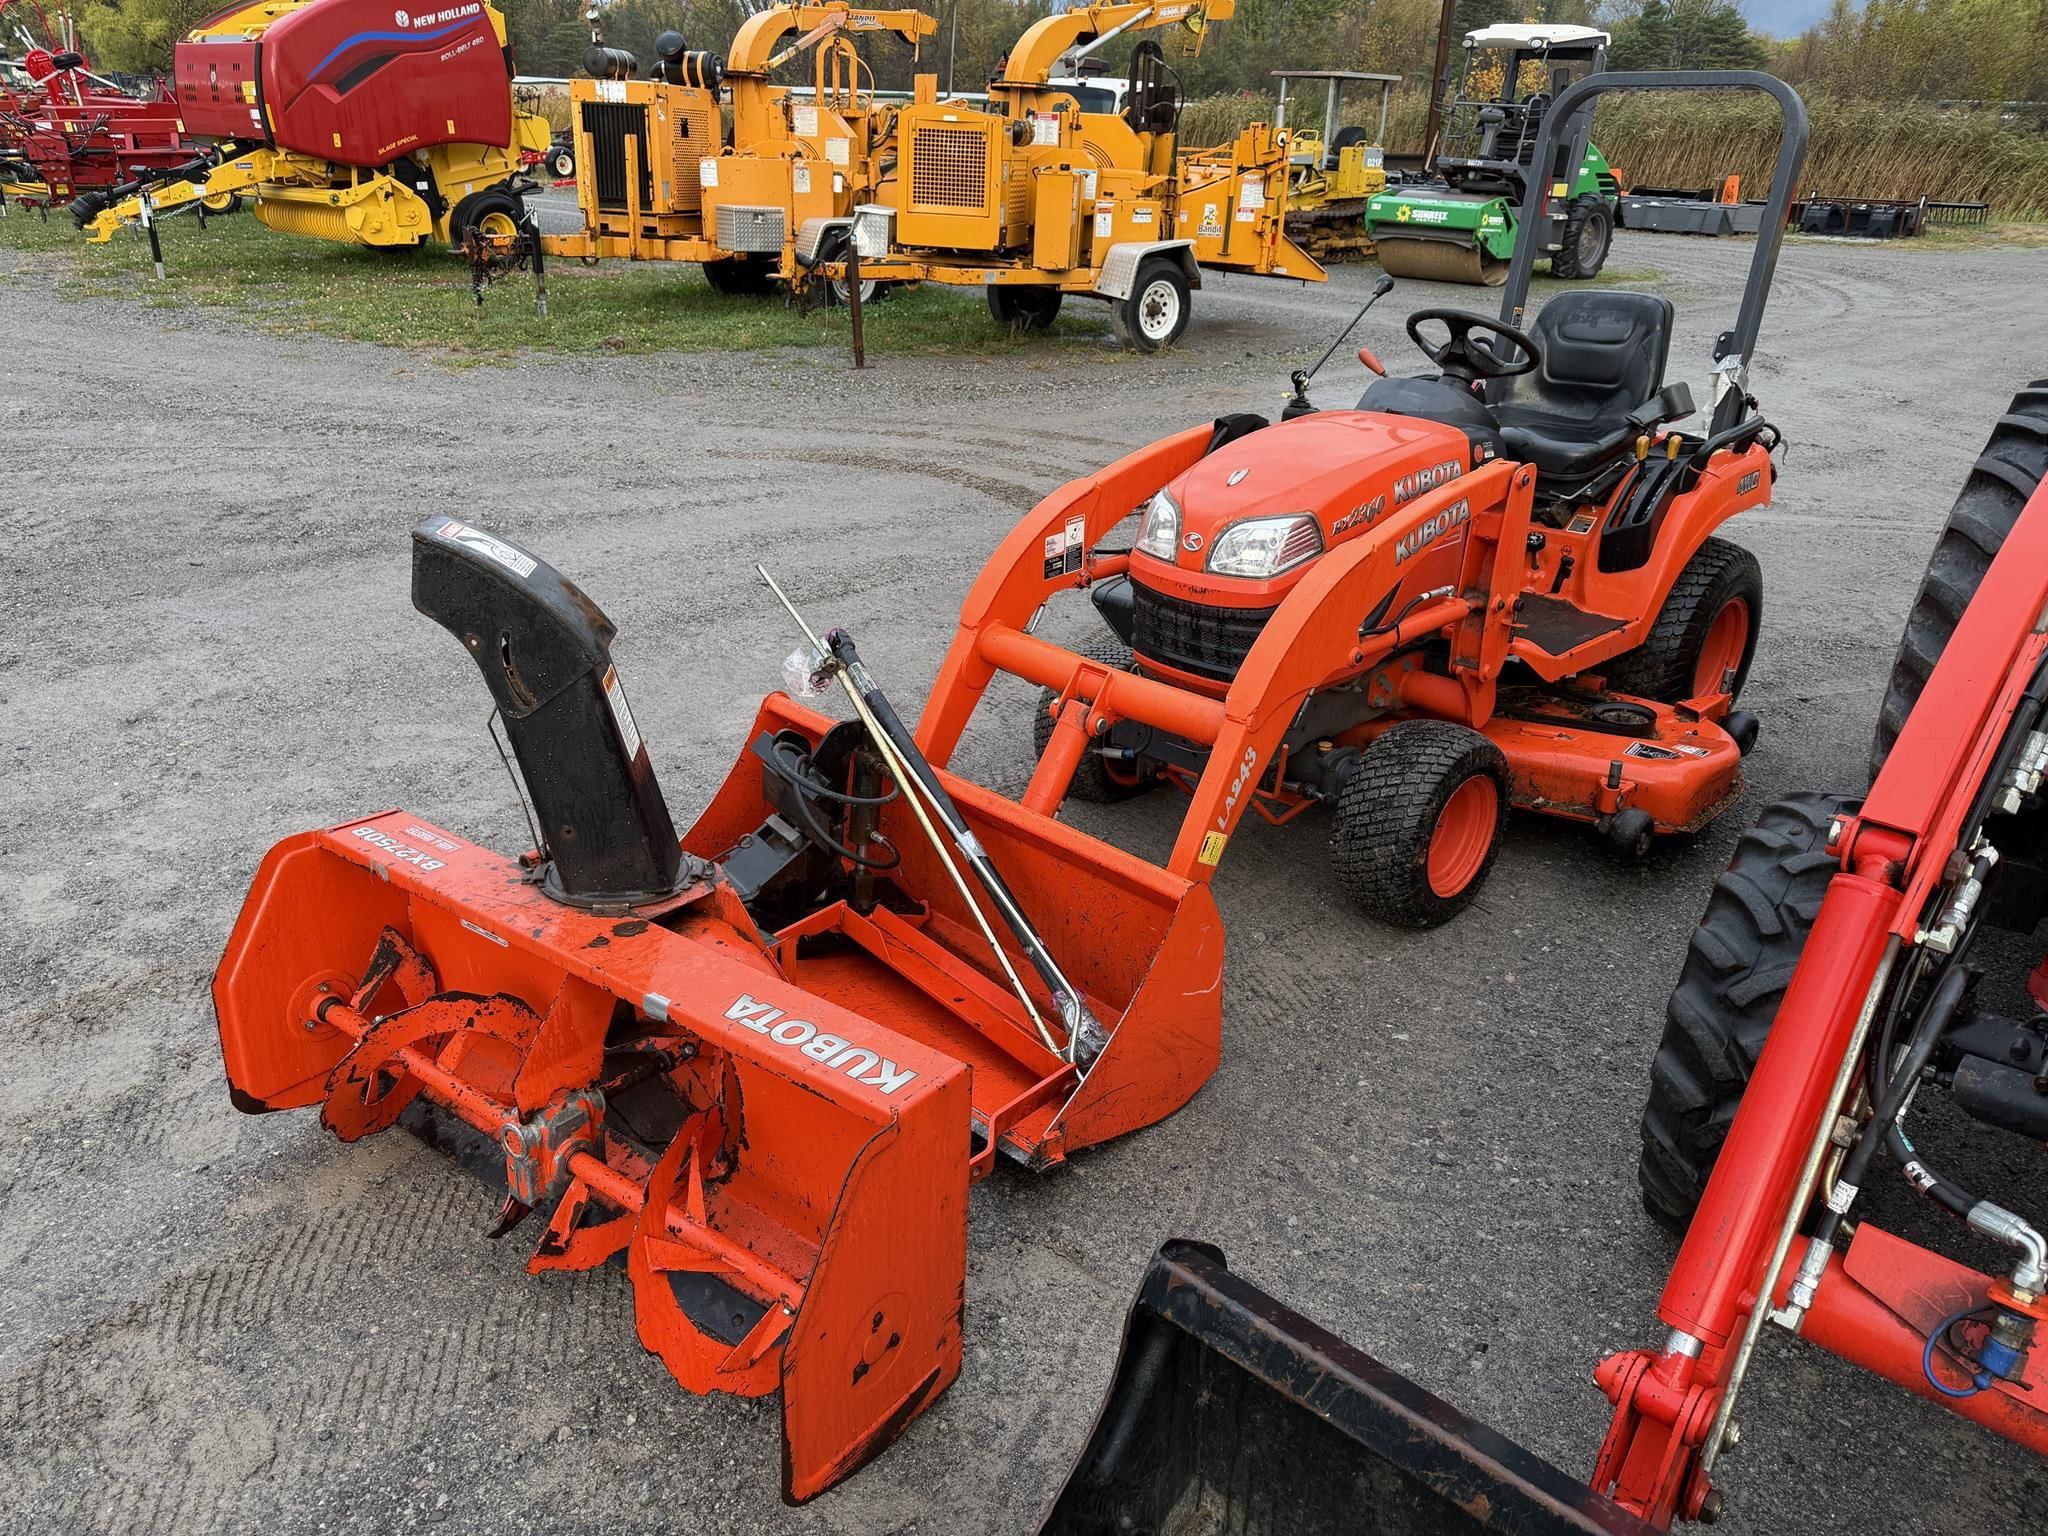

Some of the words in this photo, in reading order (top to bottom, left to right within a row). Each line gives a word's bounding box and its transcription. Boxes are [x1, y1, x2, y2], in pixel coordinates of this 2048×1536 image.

[413, 13, 436, 28] NEW
[437, 3, 480, 22] HOLLAND
[1198, 224, 1222, 233] Bandit
[1411, 209, 1448, 221] SUNBELT
[1393, 458, 1463, 505] KUBOTA
[1330, 494, 1386, 537] BX2360
[1395, 496, 1470, 567] KUBOTA
[1217, 745, 1257, 831] LA243
[351, 827, 447, 871] BX2750B
[723, 992, 920, 1095] KUBOTA
